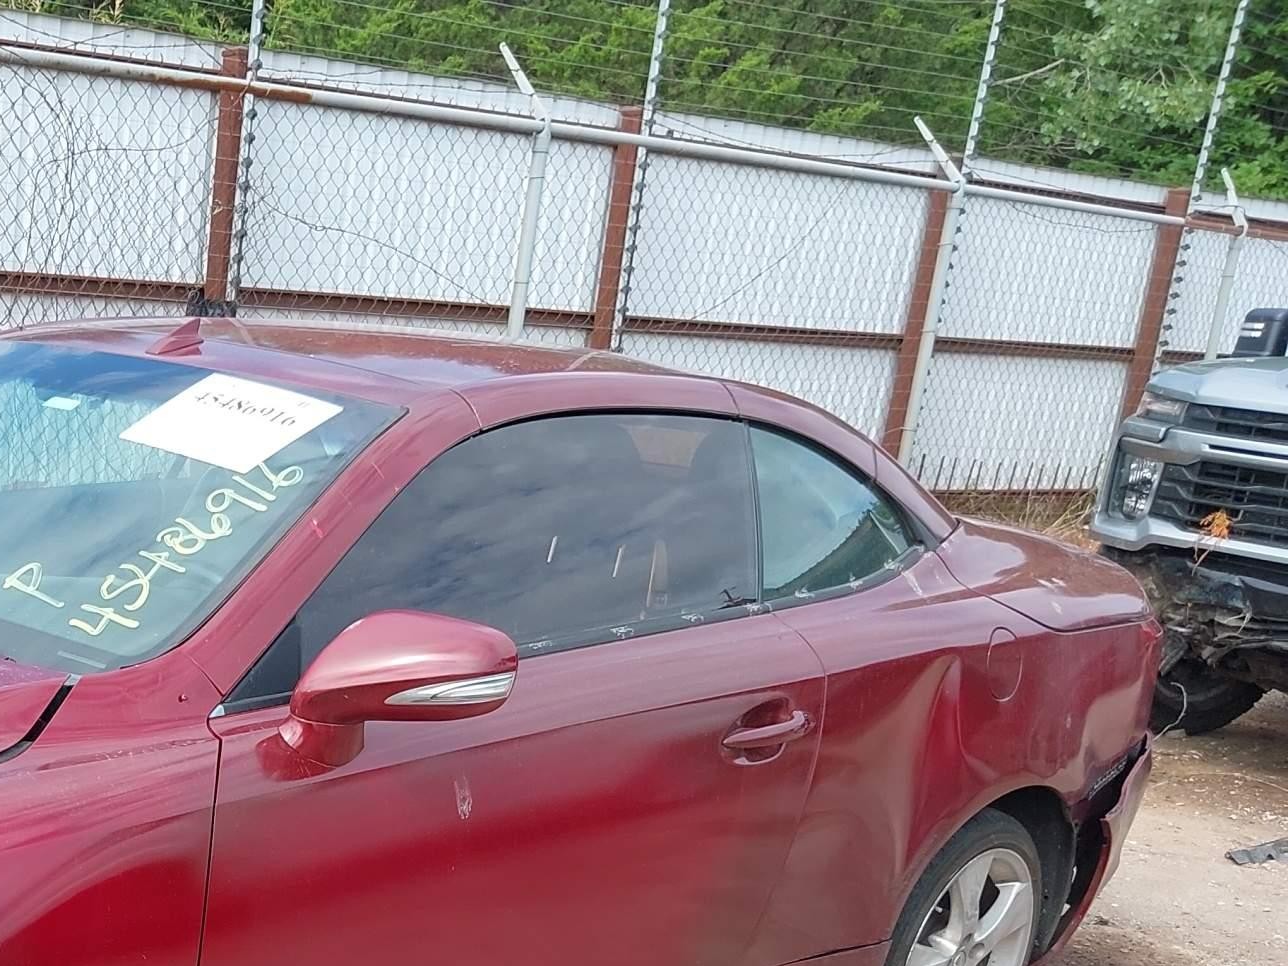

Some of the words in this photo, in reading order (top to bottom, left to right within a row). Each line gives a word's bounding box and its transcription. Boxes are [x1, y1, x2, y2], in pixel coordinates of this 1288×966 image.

[195, 391, 296, 426] 45486916
[69, 462, 304, 636] 45486916
[3, 562, 64, 607] P
